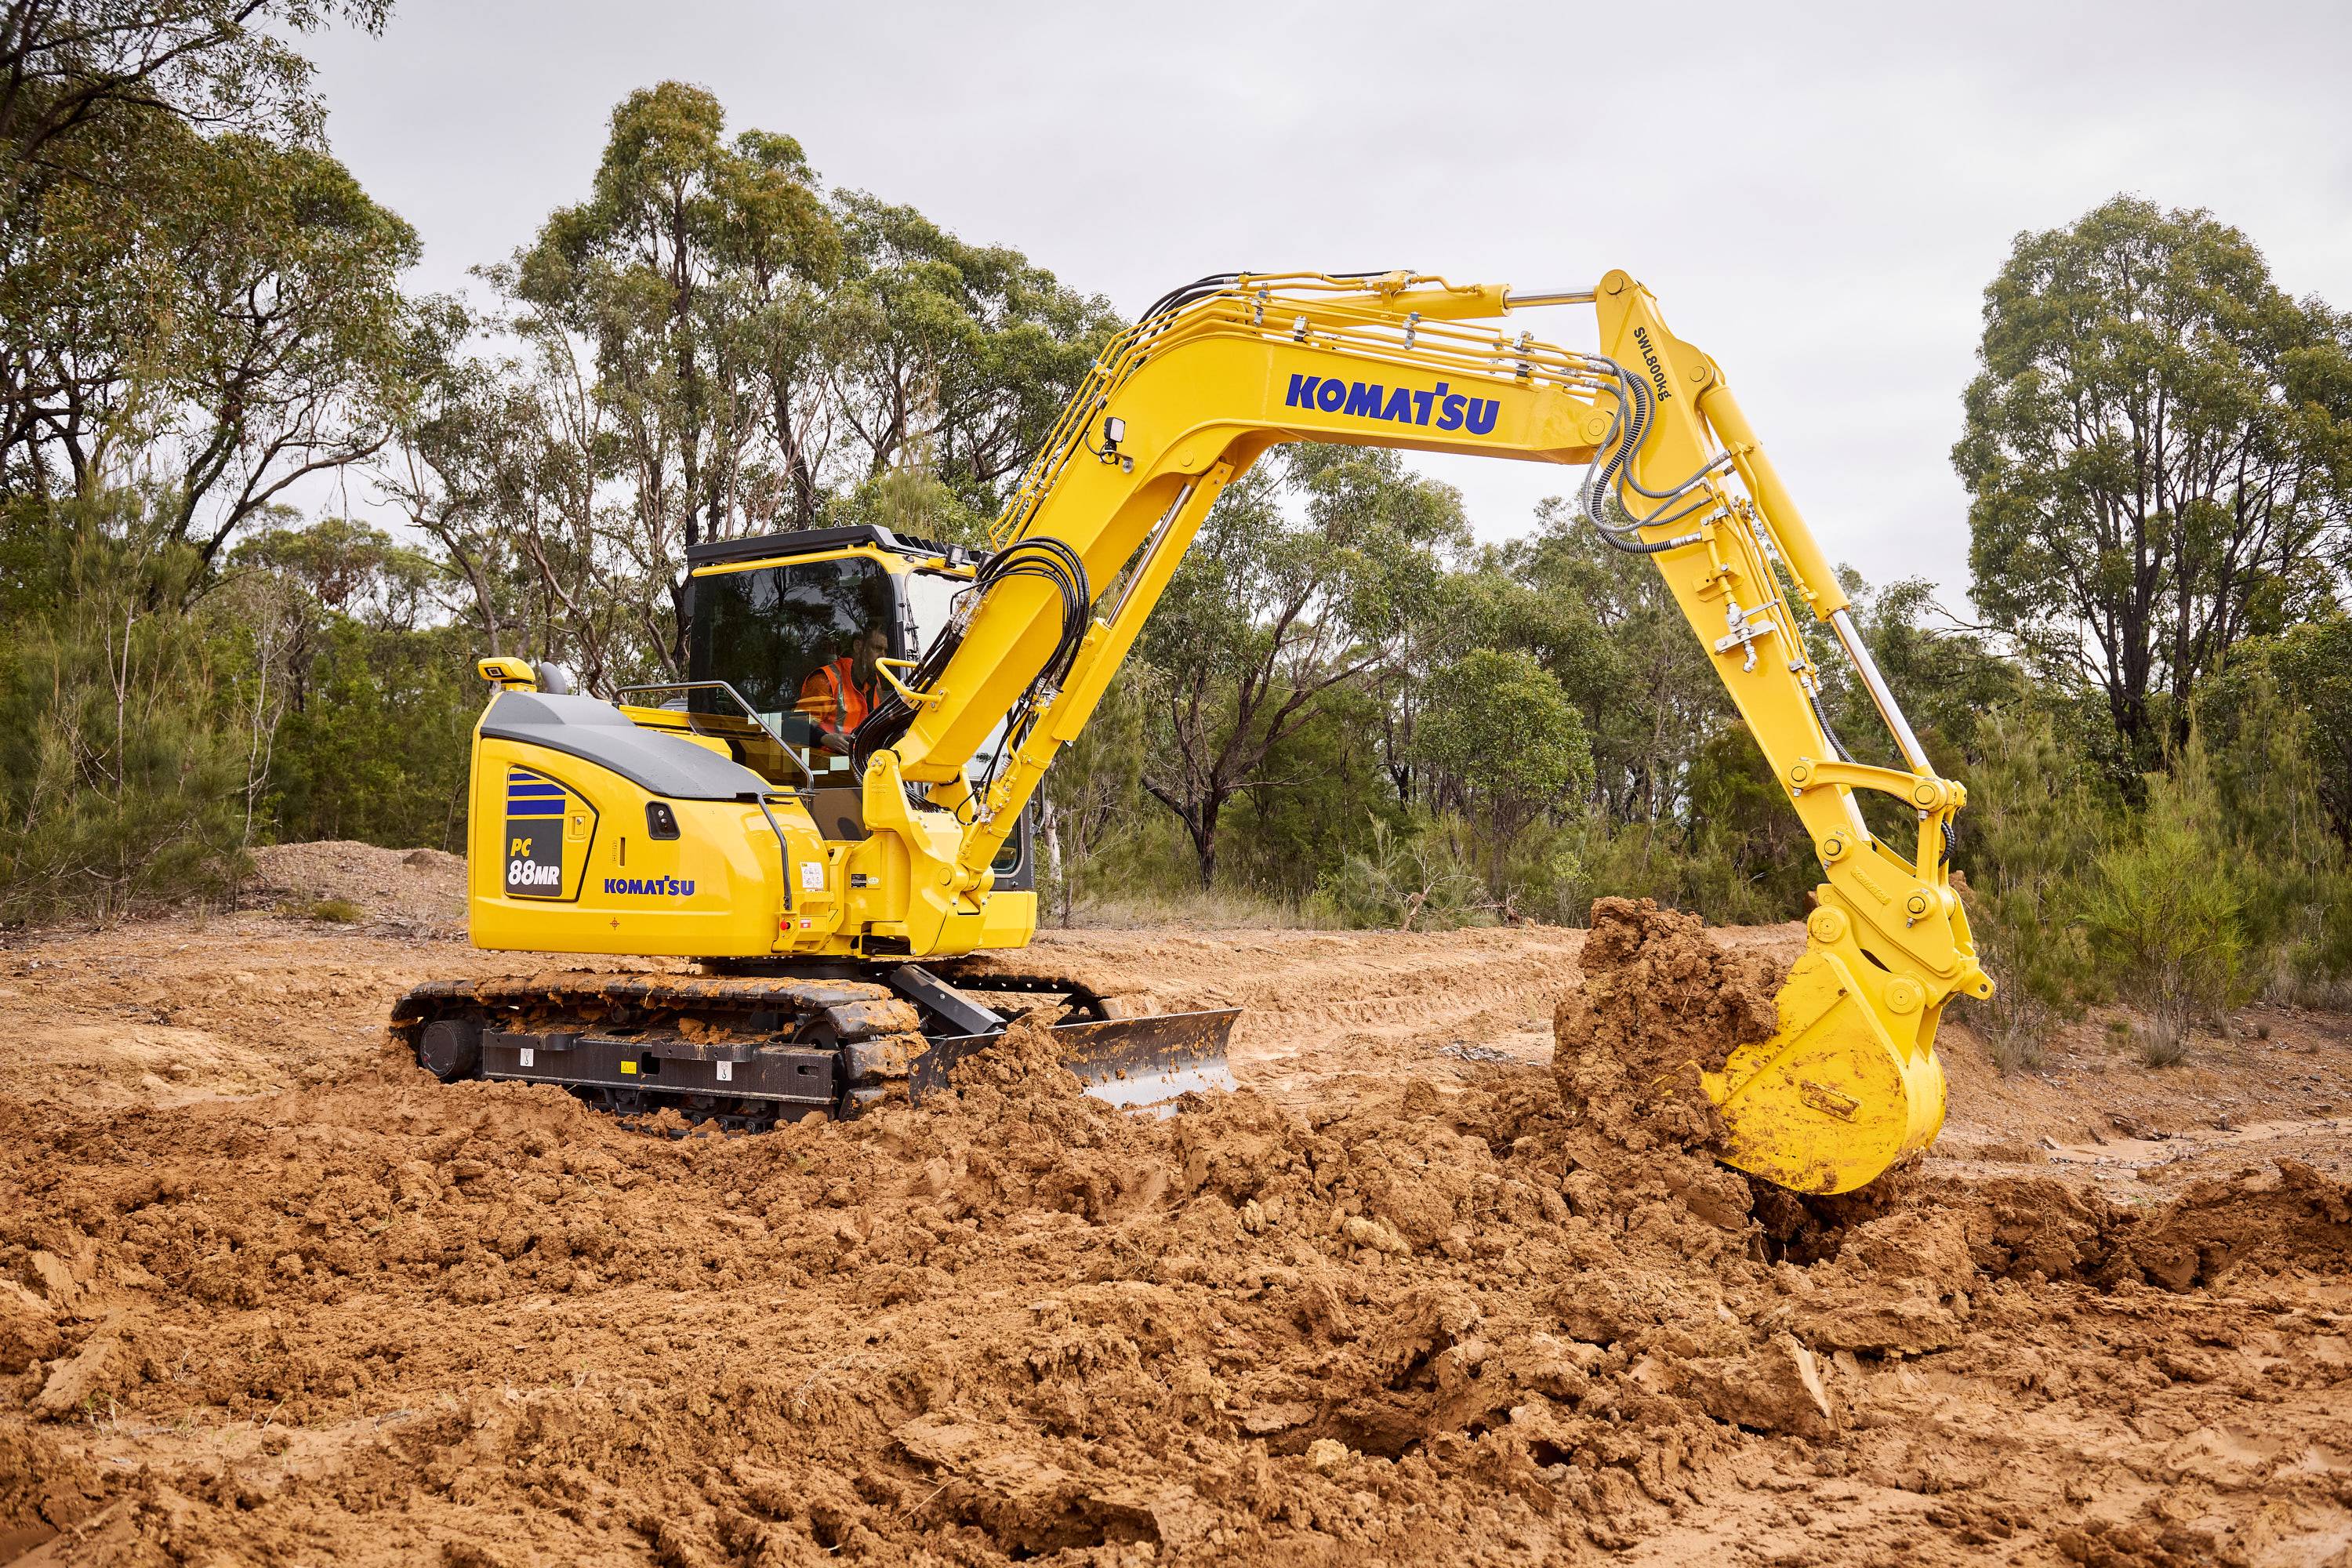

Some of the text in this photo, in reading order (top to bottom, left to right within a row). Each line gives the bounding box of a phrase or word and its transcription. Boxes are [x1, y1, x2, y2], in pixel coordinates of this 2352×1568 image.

[1633, 326, 1671, 402] SWL800kg
[1285, 373, 1501, 435] KOMATSU
[510, 837, 532, 857] PC
[508, 859, 560, 885] 88MR
[604, 875, 695, 896] KOMATSU
